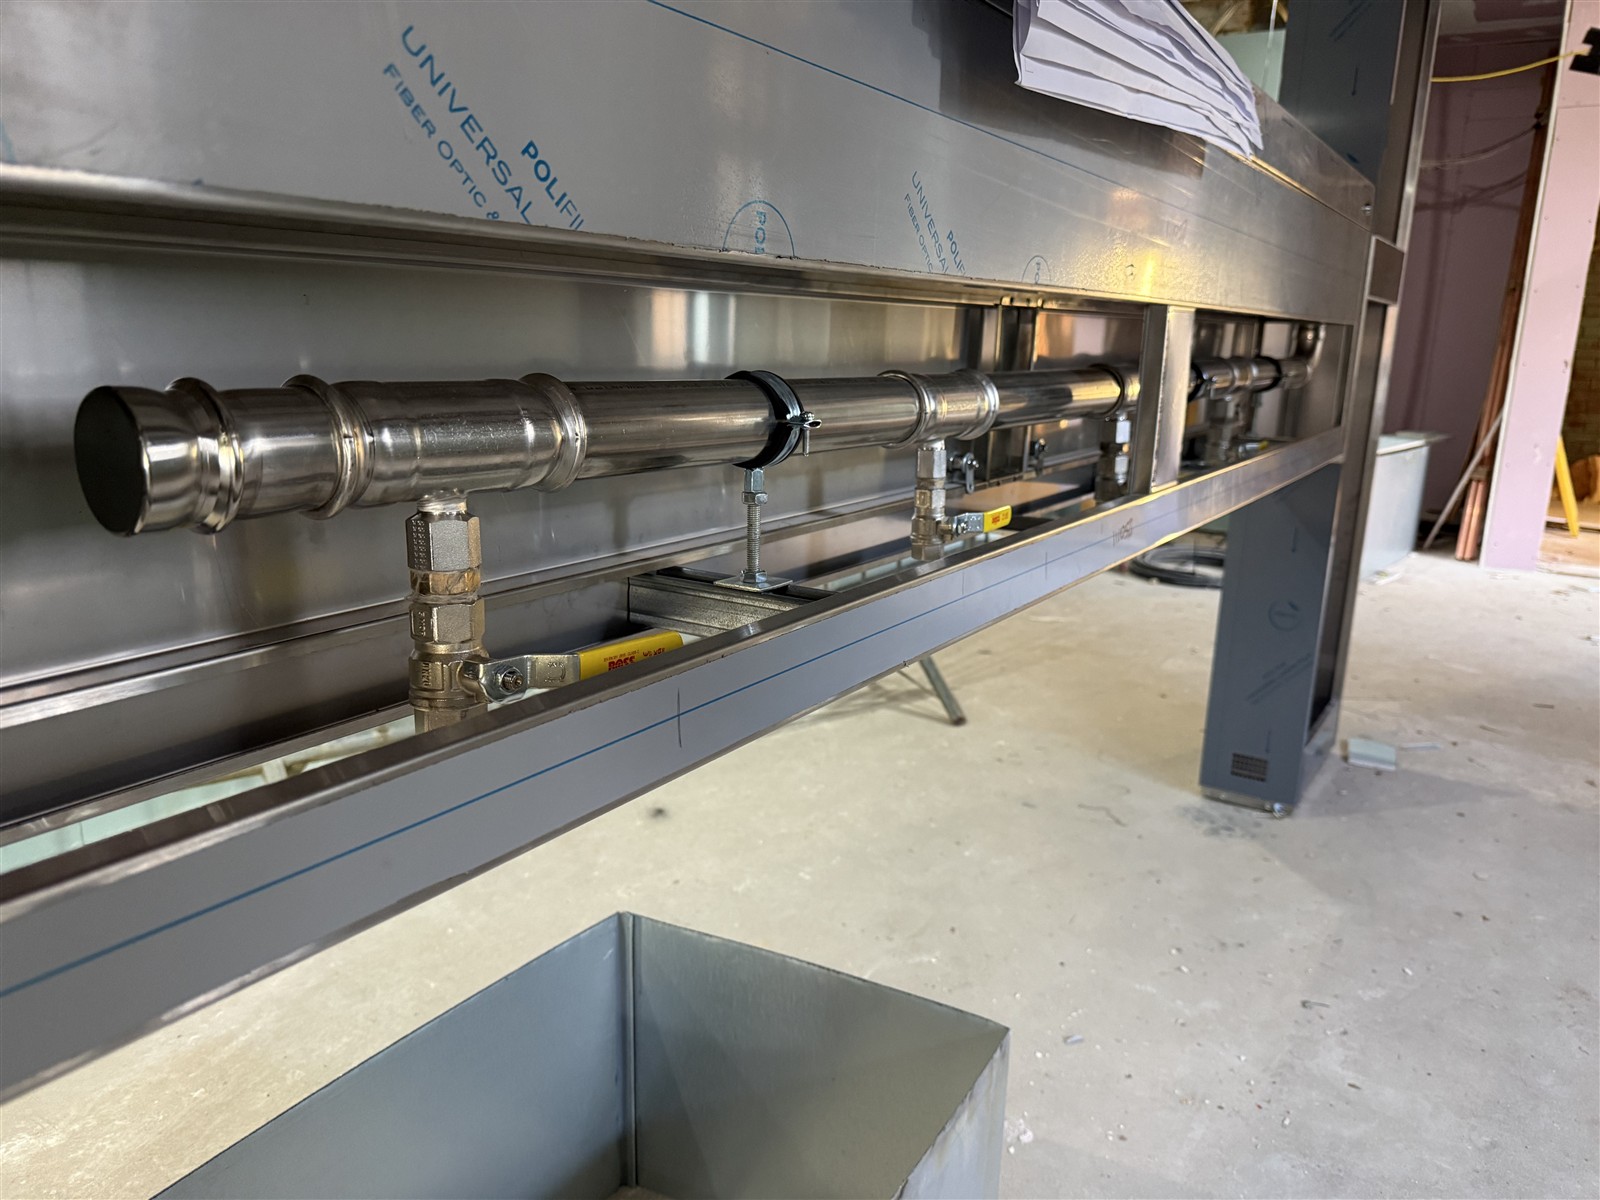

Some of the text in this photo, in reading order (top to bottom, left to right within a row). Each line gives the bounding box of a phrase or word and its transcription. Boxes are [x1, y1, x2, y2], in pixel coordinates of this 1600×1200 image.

[383, 62, 437, 139] FIBER
[437, 140, 487, 208] OPTIC
[401, 25, 533, 224] UNIVERSAL
[904, 193, 934, 273] FIBER OPTIC
[947, 230, 966, 275] POLIF
